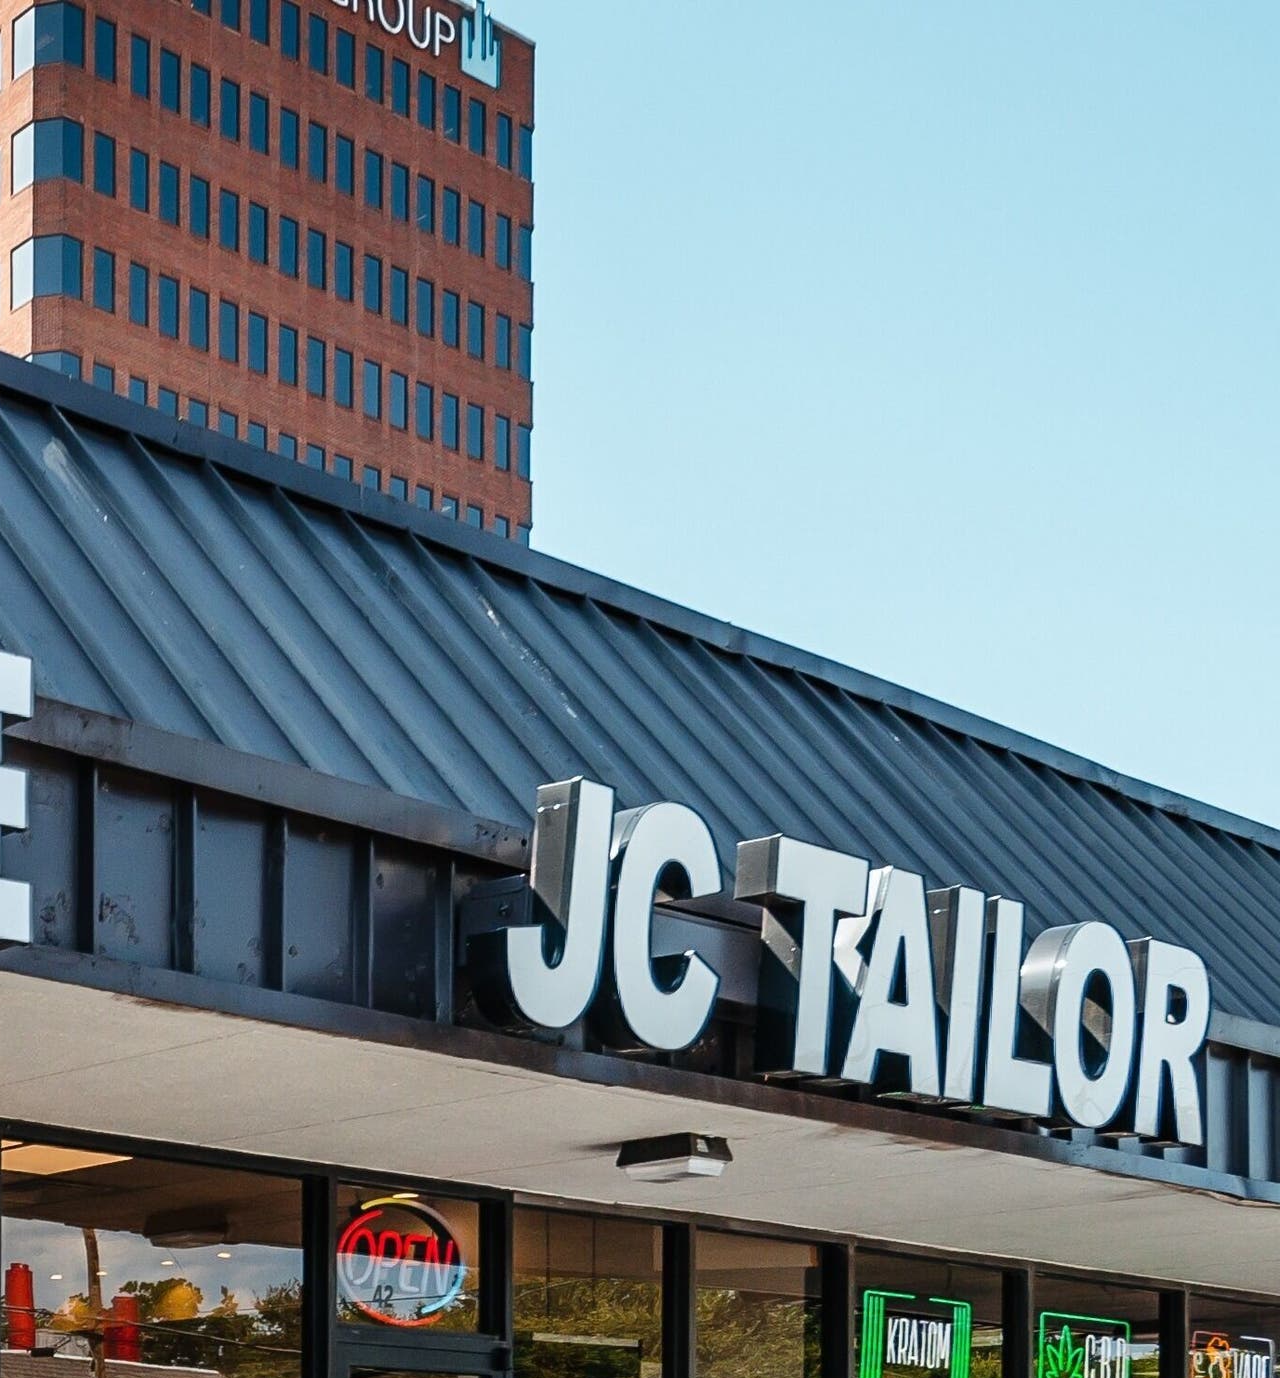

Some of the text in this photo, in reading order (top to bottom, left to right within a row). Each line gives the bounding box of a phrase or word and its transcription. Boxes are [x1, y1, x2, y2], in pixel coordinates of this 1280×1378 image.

[506, 777, 1211, 1146] JC TAILOR
[346, 1226, 454, 1296] OPEN
[886, 1317, 952, 1370] KRATOM
